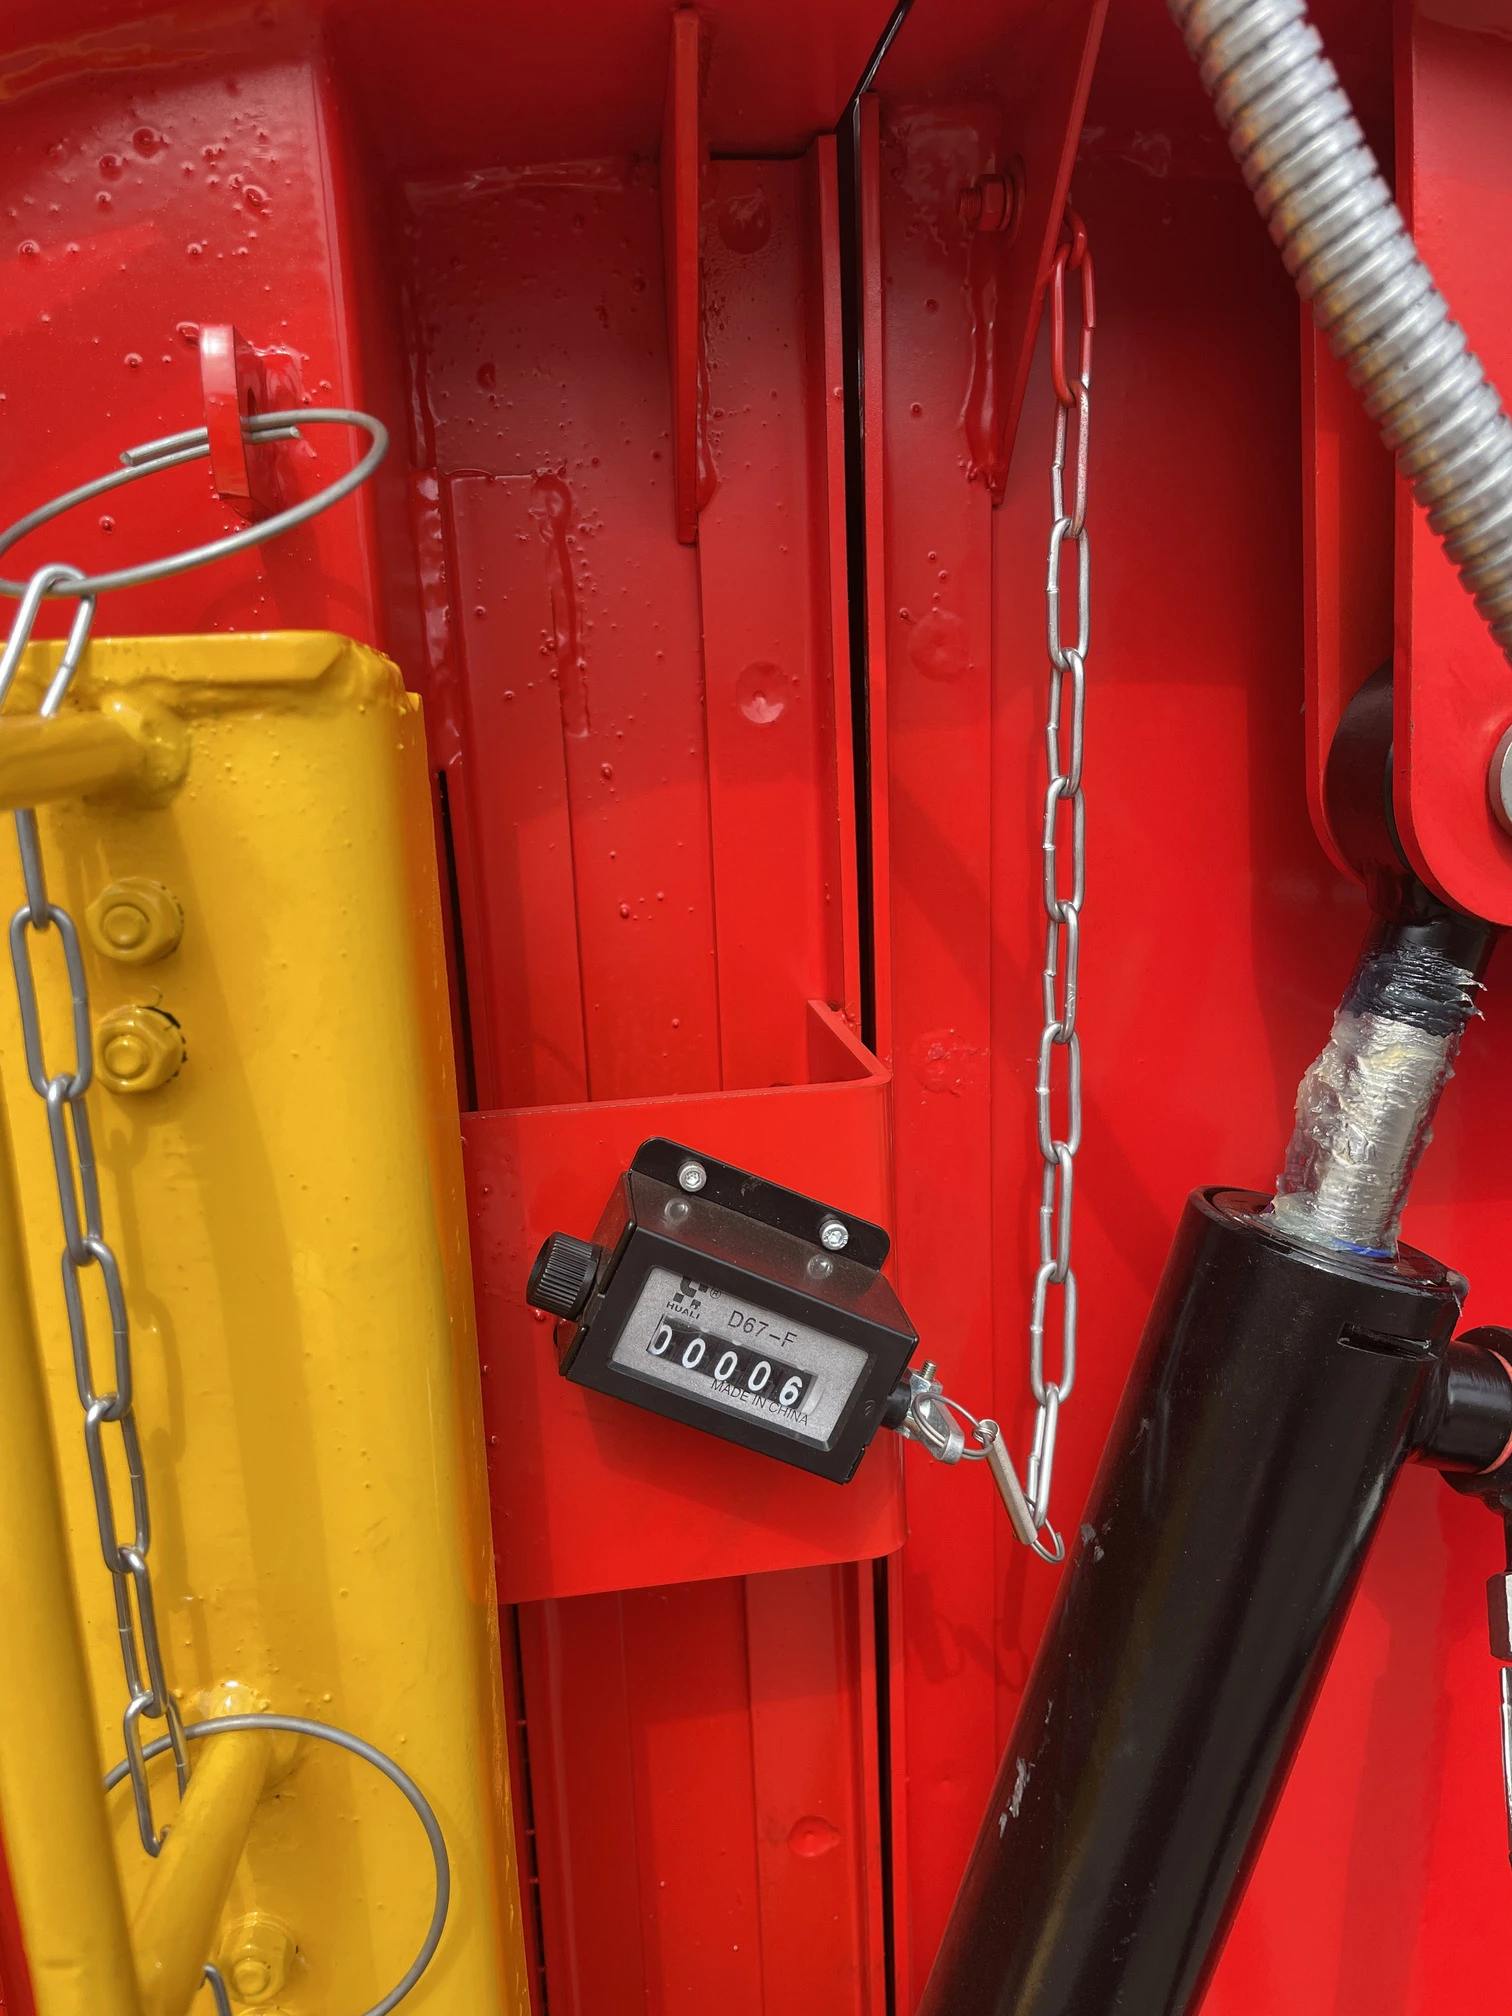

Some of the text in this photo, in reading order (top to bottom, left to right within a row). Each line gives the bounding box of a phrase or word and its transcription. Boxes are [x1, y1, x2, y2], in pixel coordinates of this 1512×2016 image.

[666, 1301, 700, 1319] HUALI
[727, 1310, 797, 1348] D67-F
[650, 1324, 803, 1406] 00006
[711, 1378, 808, 1426] MADE IN CHINA
